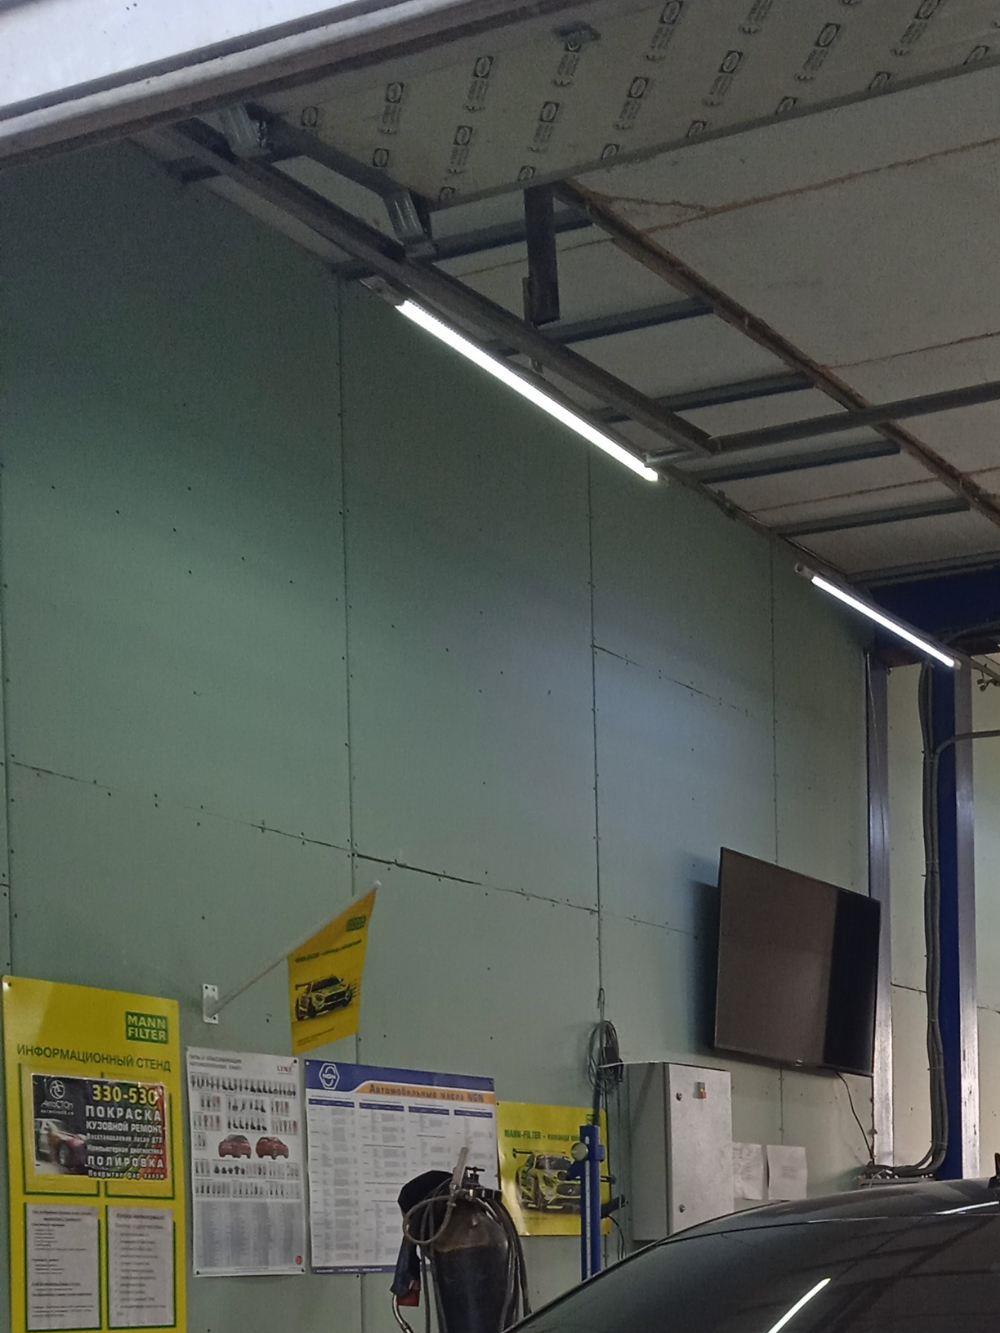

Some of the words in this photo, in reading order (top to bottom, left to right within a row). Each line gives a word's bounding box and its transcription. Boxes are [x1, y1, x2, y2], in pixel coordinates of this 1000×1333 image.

[127, 1014, 167, 1028] MANN
[127, 1028, 167, 1041] FILTER
[17, 1044, 134, 1067] ИНФОРМАЦИОННЫЙ
[136, 1057, 171, 1072] СТЕНД
[92, 1084, 158, 1105] 330-530
[85, 1105, 162, 1122] ПОКРАСКА
[85, 1120, 129, 1132] КУЗОВНОЙ
[130, 1123, 162, 1134] РЕМОНТ
[87, 1155, 164, 1168] ПОЛИРОВКА
